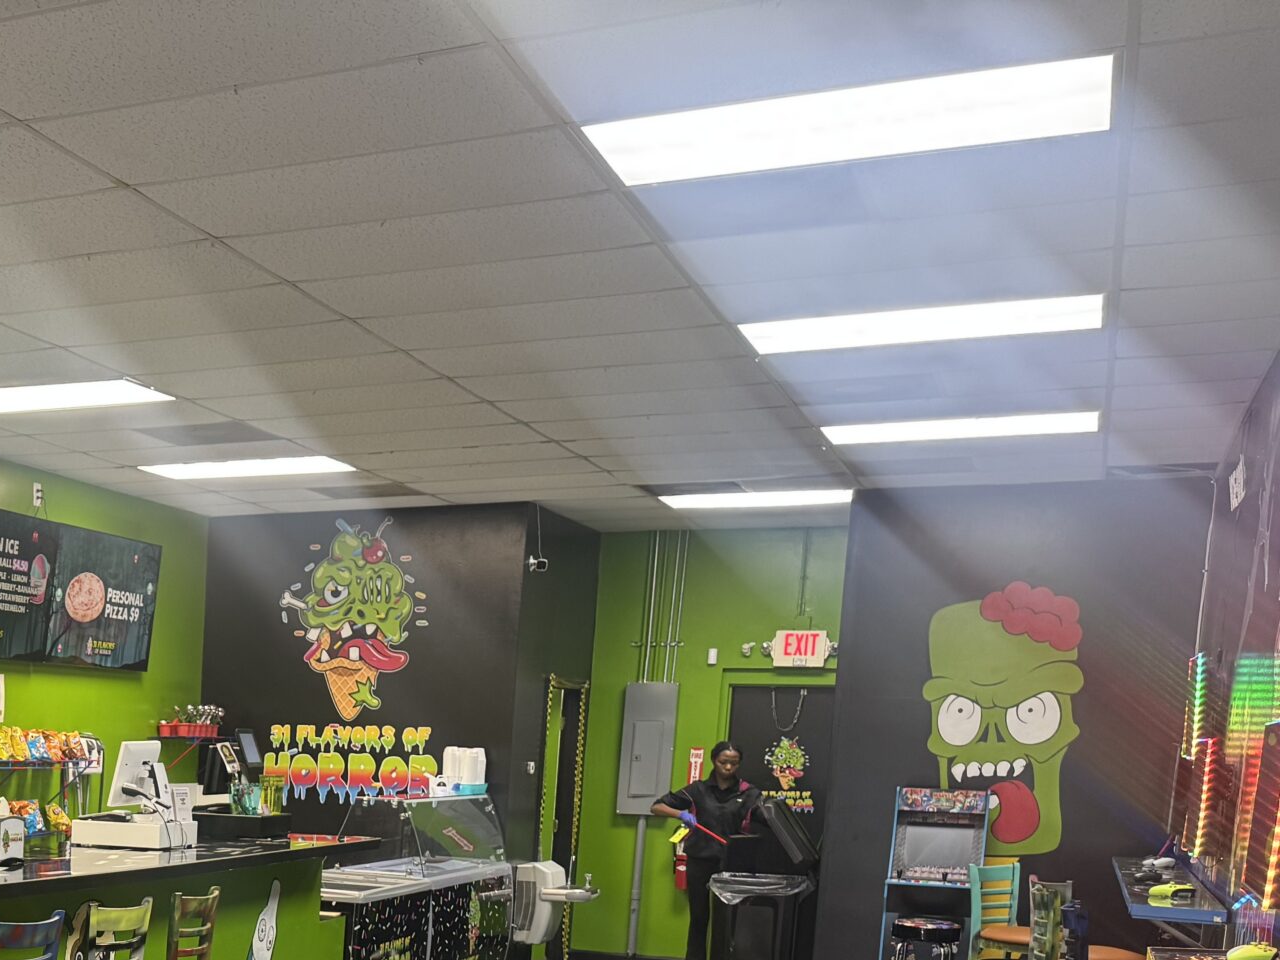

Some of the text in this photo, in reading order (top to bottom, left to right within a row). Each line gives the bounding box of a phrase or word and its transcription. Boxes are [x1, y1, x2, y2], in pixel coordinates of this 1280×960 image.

[5, 538, 20, 555] ICE
[12, 559, 28, 572] $4.50
[11, 574, 28, 583] LEMON
[0, 592, 29, 603] STRAWBERRY
[107, 587, 144, 607] PERSONAL
[104, 603, 140, 623] PIZZA $9
[783, 633, 820, 657] EXIT
[270, 724, 432, 754] 31 FLAVORS OF
[263, 751, 438, 808] HORROR
[769, 790, 800, 800] FLAVORS
[801, 790, 812, 799] OF
